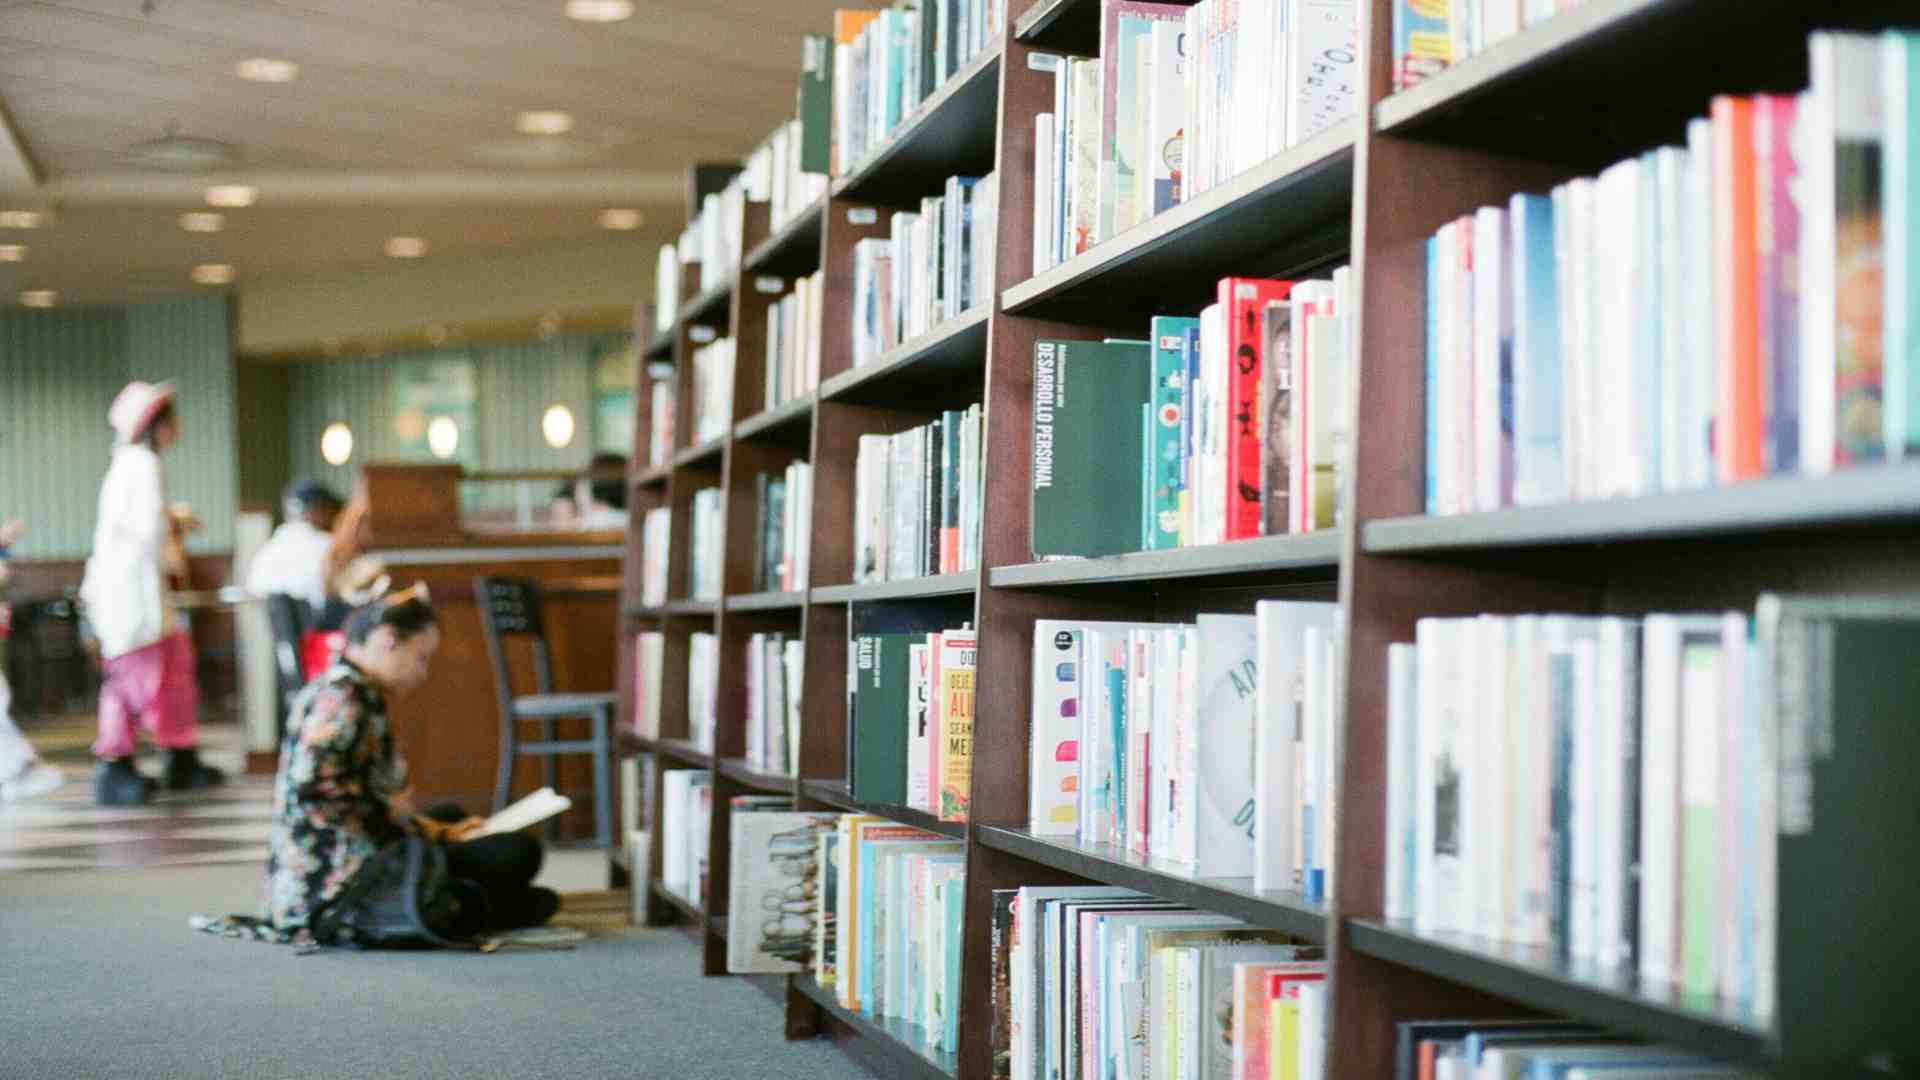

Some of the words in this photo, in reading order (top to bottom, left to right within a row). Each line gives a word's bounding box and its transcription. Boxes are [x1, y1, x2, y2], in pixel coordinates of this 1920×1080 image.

[1036, 343, 1055, 422] DESARROLLO
[1034, 424, 1053, 489] PERSONAL
[859, 637, 873, 669] SALUD
